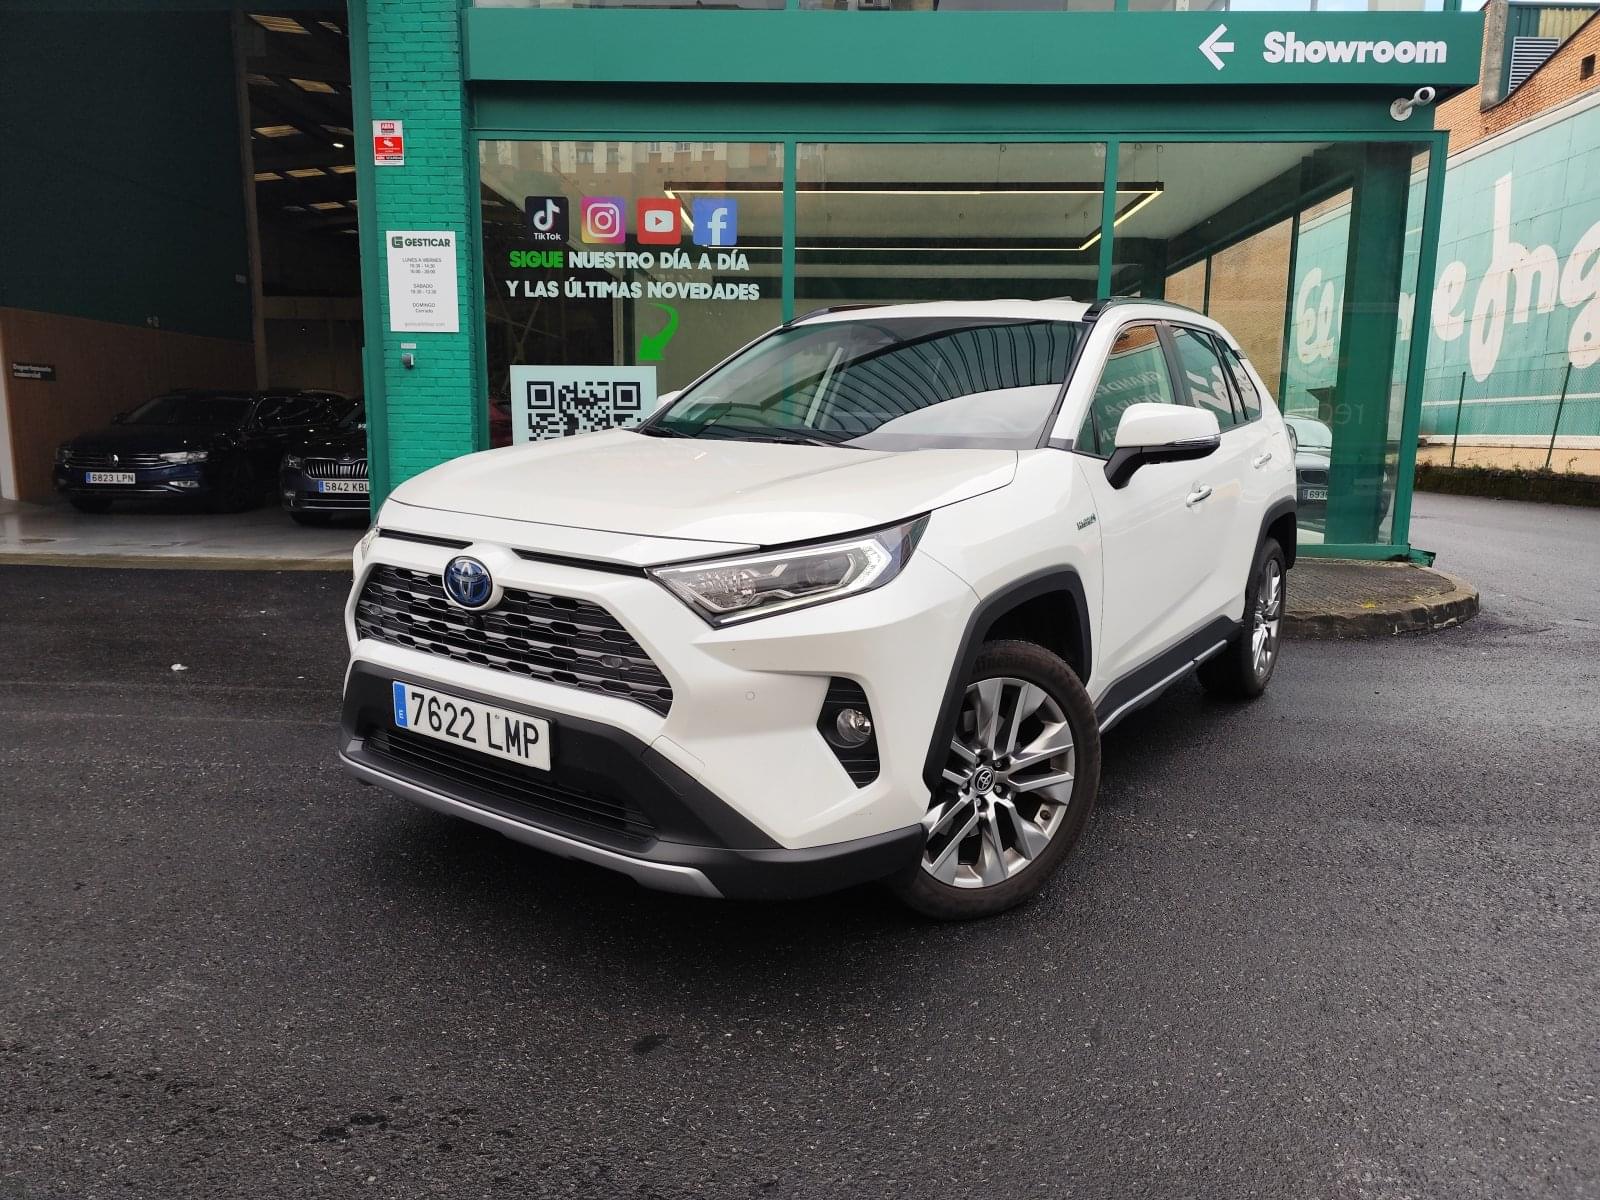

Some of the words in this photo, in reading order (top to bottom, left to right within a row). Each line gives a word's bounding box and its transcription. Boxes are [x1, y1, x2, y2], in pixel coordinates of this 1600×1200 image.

[1263, 31, 1448, 64] Showroom
[533, 231, 562, 241] TikTok
[404, 238, 451, 247] GESTICAR
[509, 251, 564, 269] SIGUE
[568, 251, 655, 270] NUESTRO
[660, 248, 693, 270] DÍA
[698, 251, 713, 270] A
[717, 248, 750, 271] DÍA
[505, 280, 519, 297] Y
[524, 280, 560, 299] LAS
[564, 277, 642, 299] ÚLTIMAS
[647, 280, 760, 301] NOVEDADES
[92, 474, 114, 482] 6823
[116, 474, 134, 483] LPN
[325, 482, 349, 492] 5842
[398, 710, 404, 719] E
[411, 692, 477, 744] 7622
[486, 712, 539, 758] LMP
